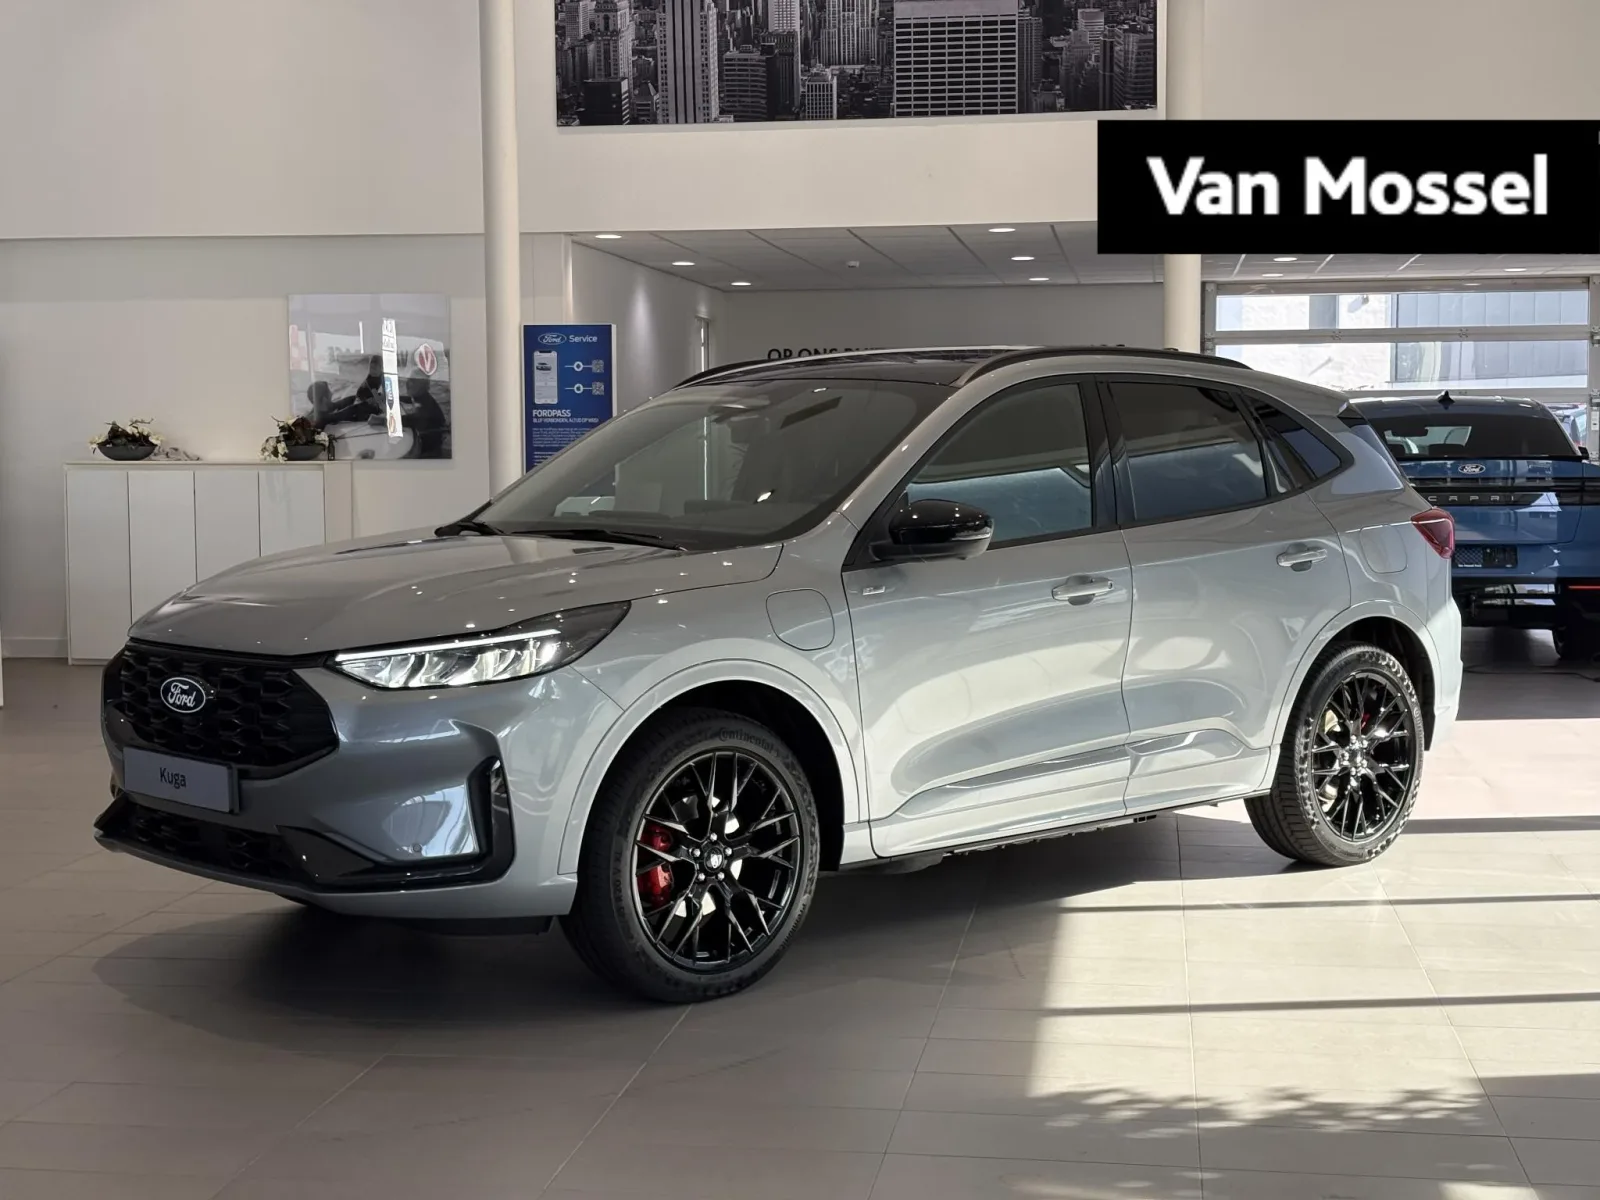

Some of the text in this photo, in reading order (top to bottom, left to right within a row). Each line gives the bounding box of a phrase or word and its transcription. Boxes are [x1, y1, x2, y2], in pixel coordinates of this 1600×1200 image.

[568, 335, 598, 343] Service
[532, 409, 571, 417] FORDPASS
[159, 766, 187, 789] Kuga
